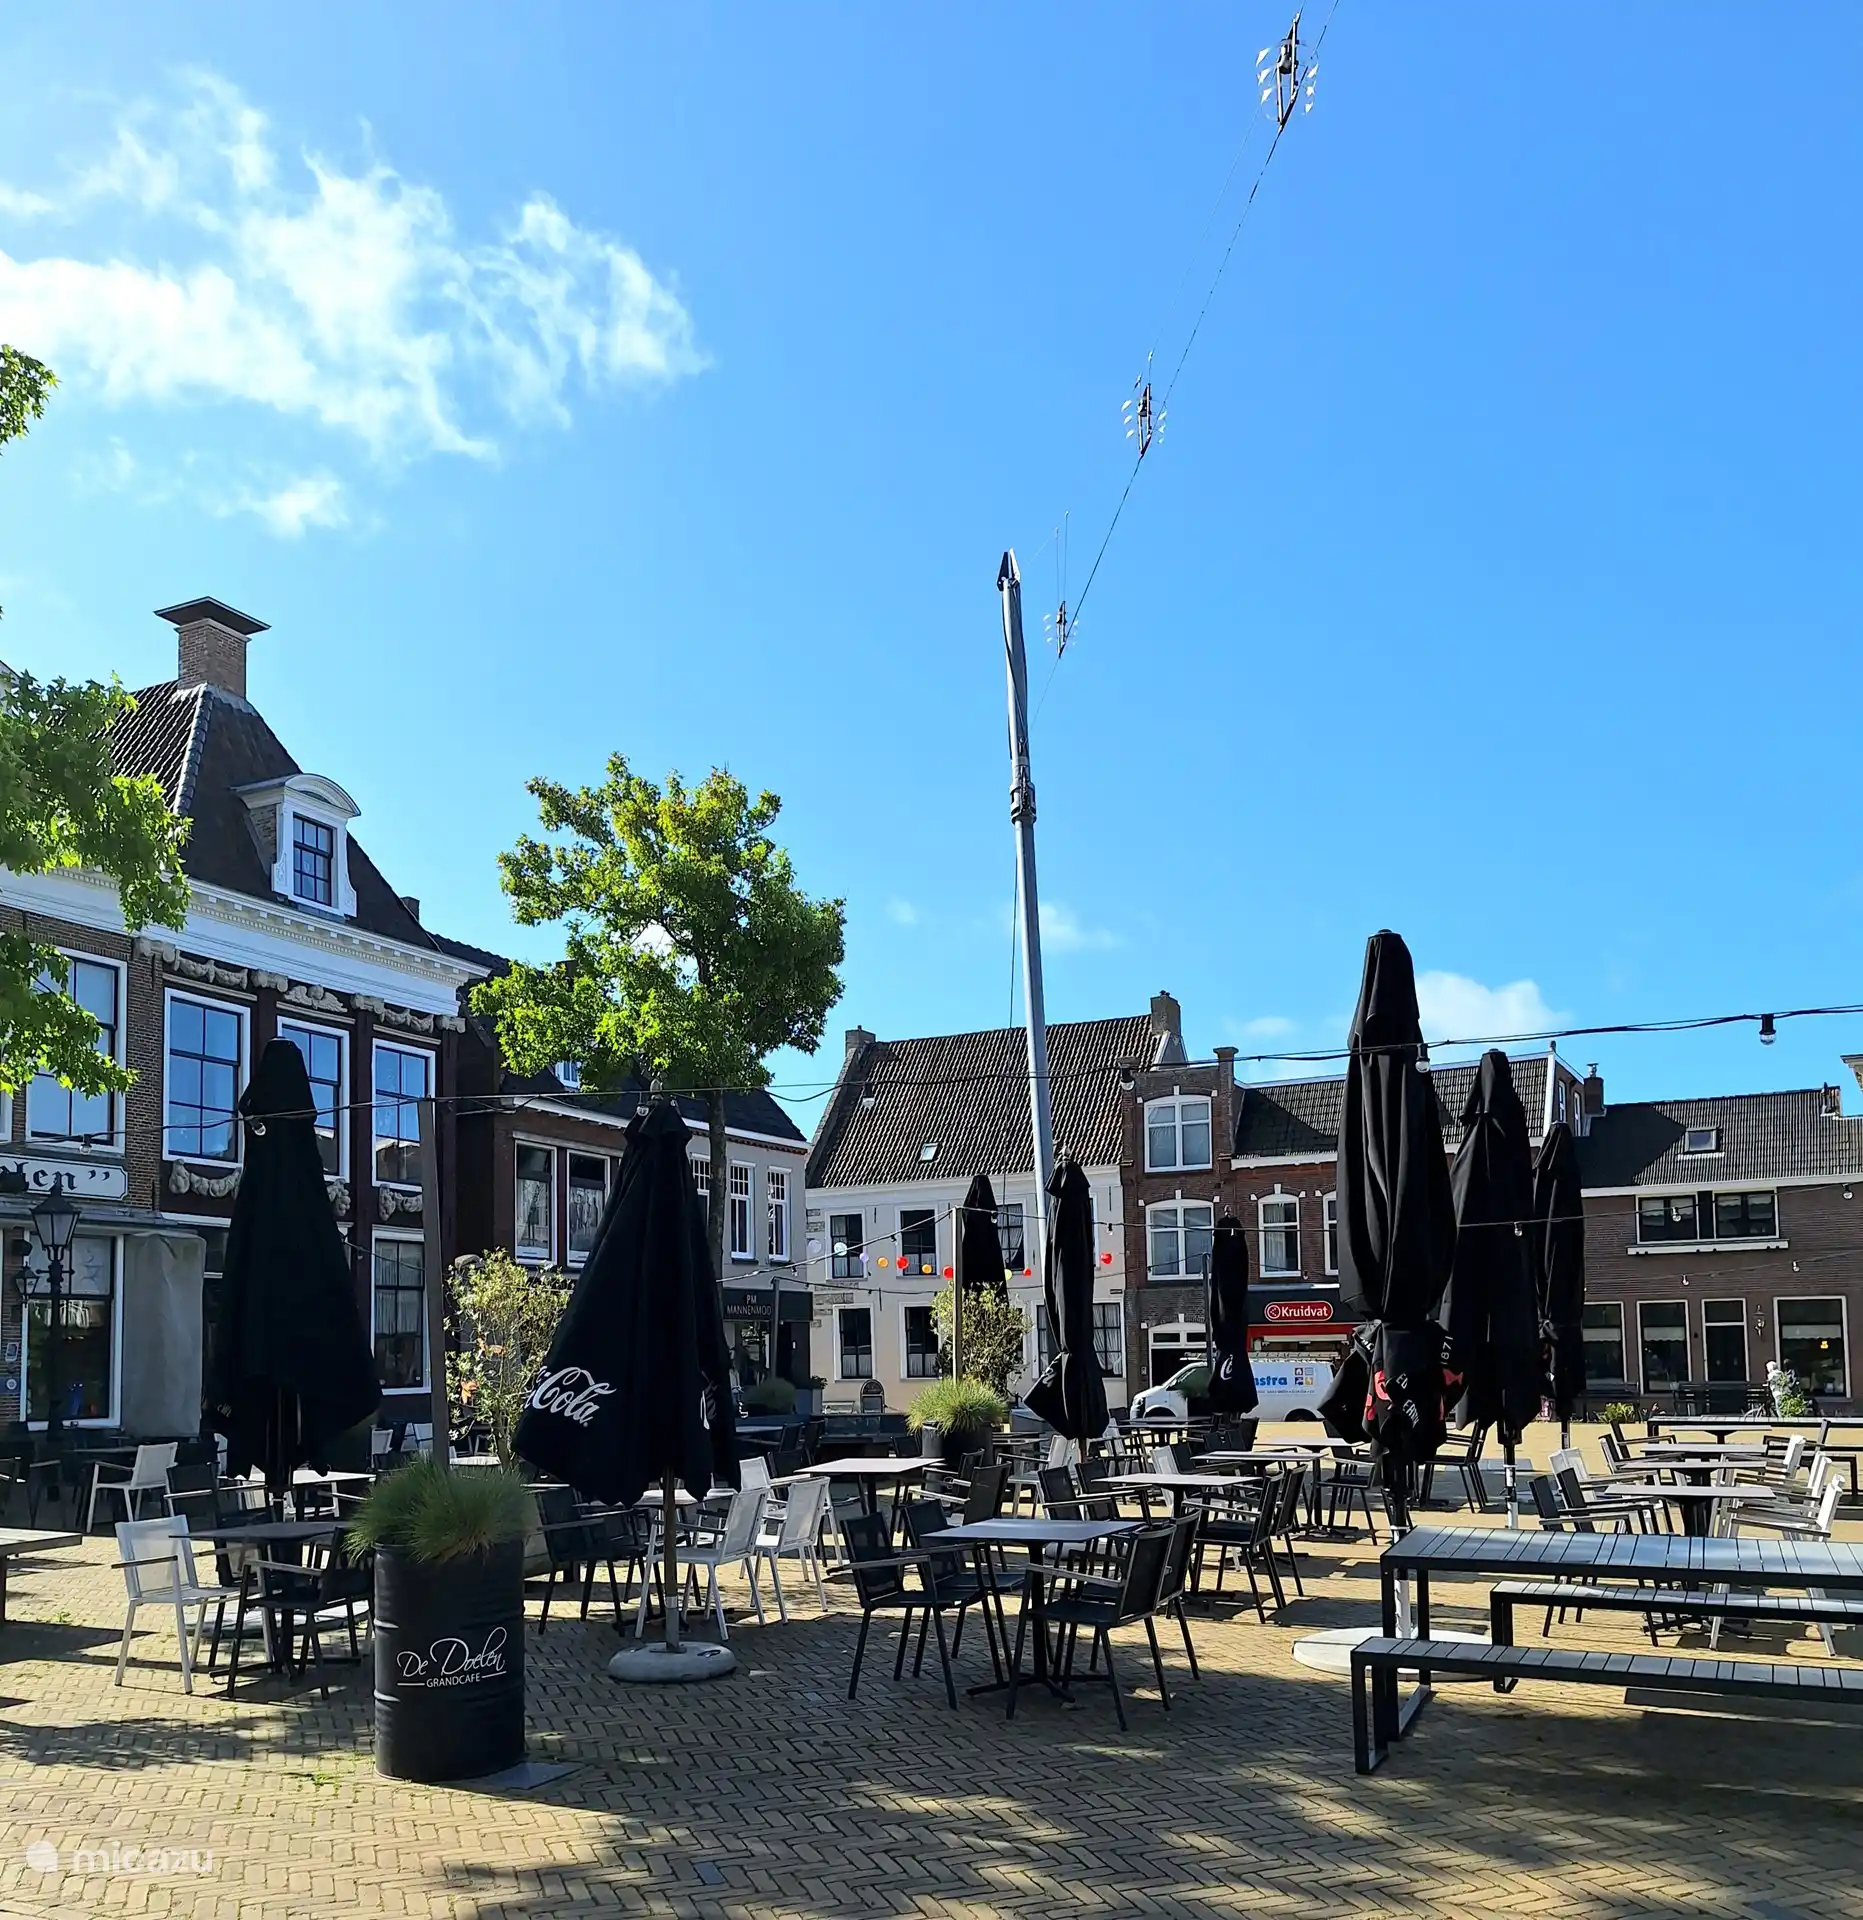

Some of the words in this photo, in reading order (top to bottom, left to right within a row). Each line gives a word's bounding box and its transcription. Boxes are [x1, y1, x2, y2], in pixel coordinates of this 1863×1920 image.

[746, 1294, 757, 1304] PM
[727, 1305, 773, 1315] MANNENMOD
[1281, 1305, 1329, 1317] Kruidvat
[397, 1651, 429, 1677] De
[429, 1626, 507, 1676] Doelen
[426, 1673, 481, 1688] GRANDCAFE
